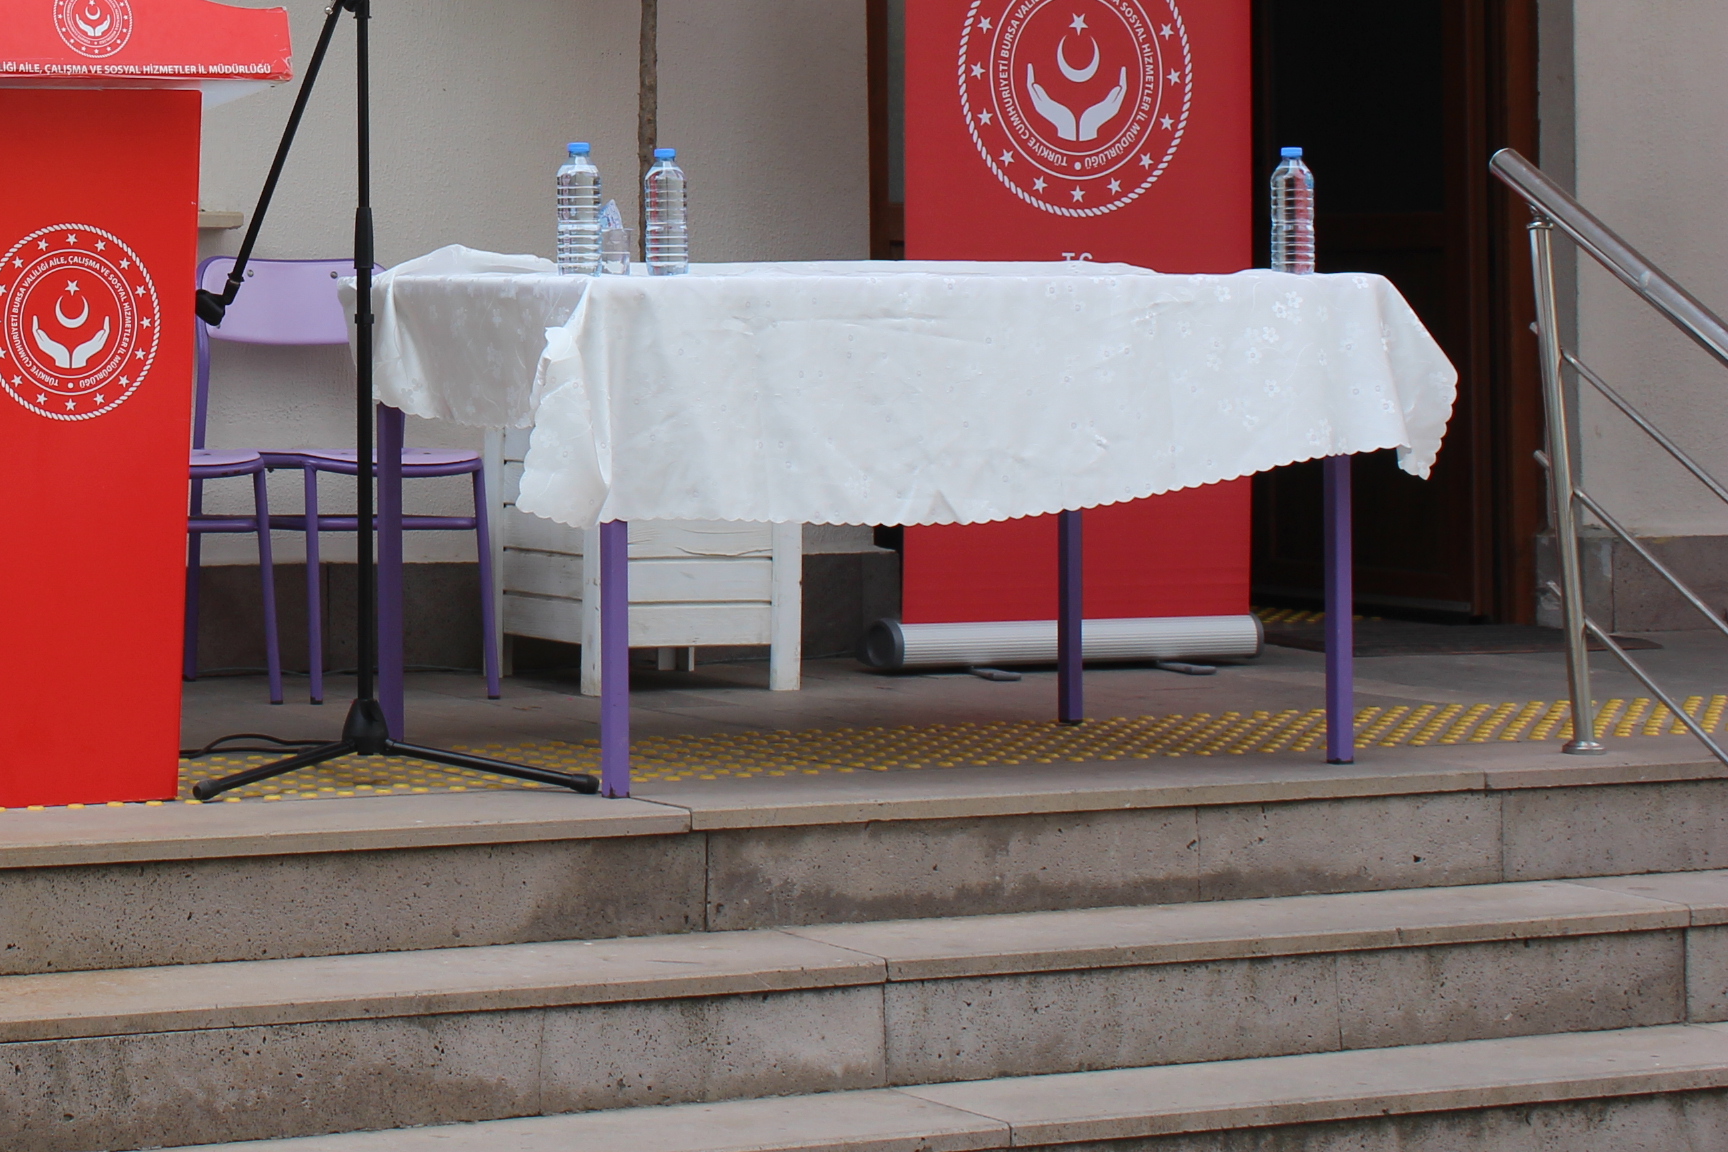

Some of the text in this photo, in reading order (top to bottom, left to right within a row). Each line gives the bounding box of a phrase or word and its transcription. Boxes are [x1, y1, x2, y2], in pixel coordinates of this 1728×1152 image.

[1001, 20, 1020, 57] BURSA
[1120, 2, 1146, 42] SOSYAL
[19, 62, 42, 73] AİLE,
[44, 64, 88, 75] ÇALIŞMA
[89, 64, 102, 74] VE
[104, 64, 141, 74] SOSYAL
[143, 63, 196, 74] HİZMETLER
[198, 63, 207, 74] İL
[209, 63, 271, 74] MÜDÜRLÜĞÜ
[1141, 44, 1154, 110] HİZMETLER
[998, 60, 1029, 139] CUMHURİYETİ
[1136, 112, 1148, 121] İL
[1028, 137, 1067, 166] TÜRKİYE
[1085, 123, 1140, 169] MÜDÜRLÜĞÜ
